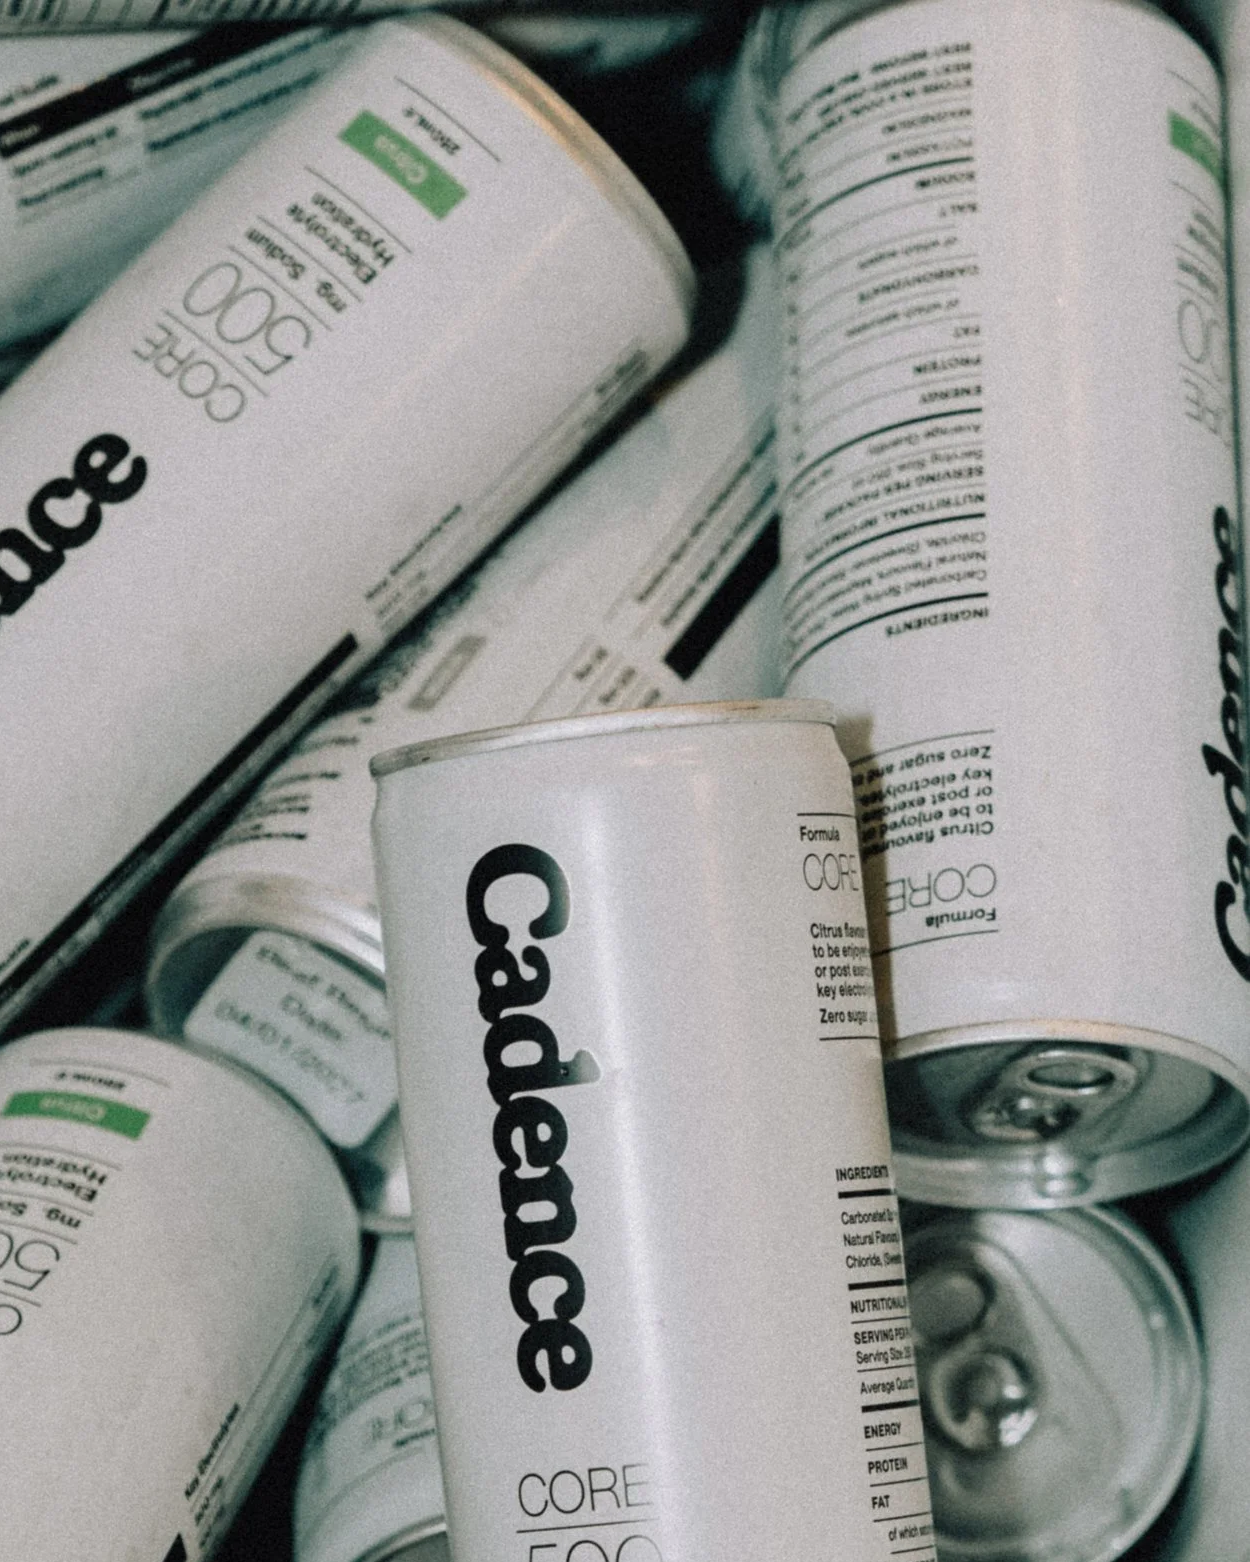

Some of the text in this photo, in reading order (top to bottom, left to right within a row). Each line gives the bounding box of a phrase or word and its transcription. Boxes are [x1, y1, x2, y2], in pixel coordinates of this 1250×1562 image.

[311, 192, 395, 268] Hydration
[286, 203, 377, 285] Electrolyte
[245, 228, 305, 280] Sodium
[183, 262, 312, 376] 500
[134, 322, 246, 423] CORE
[885, 606, 989, 637] INGREDIENTS
[901, 745, 992, 768] Zero sugar
[963, 768, 992, 781] key
[932, 786, 969, 801] post
[949, 805, 970, 817] be
[799, 825, 841, 842] Formula
[941, 820, 995, 837] Citrus
[803, 853, 860, 891] CORE
[886, 863, 997, 917] CORE
[926, 907, 997, 928] Formula
[810, 922, 843, 939] Citrus
[812, 944, 840, 958] to be
[814, 965, 850, 980] or post
[816, 983, 837, 1000] key
[819, 1008, 846, 1024] Zero
[465, 843, 602, 1394] Cadence
[2, 1153, 108, 1187] Hydration
[843, 1233, 874, 1247] Natural
[854, 1328, 894, 1345] SERVING
[856, 1348, 889, 1364] Serving
[860, 1380, 895, 1395] Average
[864, 1422, 902, 1439] ENERGY
[868, 1456, 908, 1474] PROTEIN
[518, 1462, 650, 1518] CORE
[871, 1495, 890, 1509] FAT
